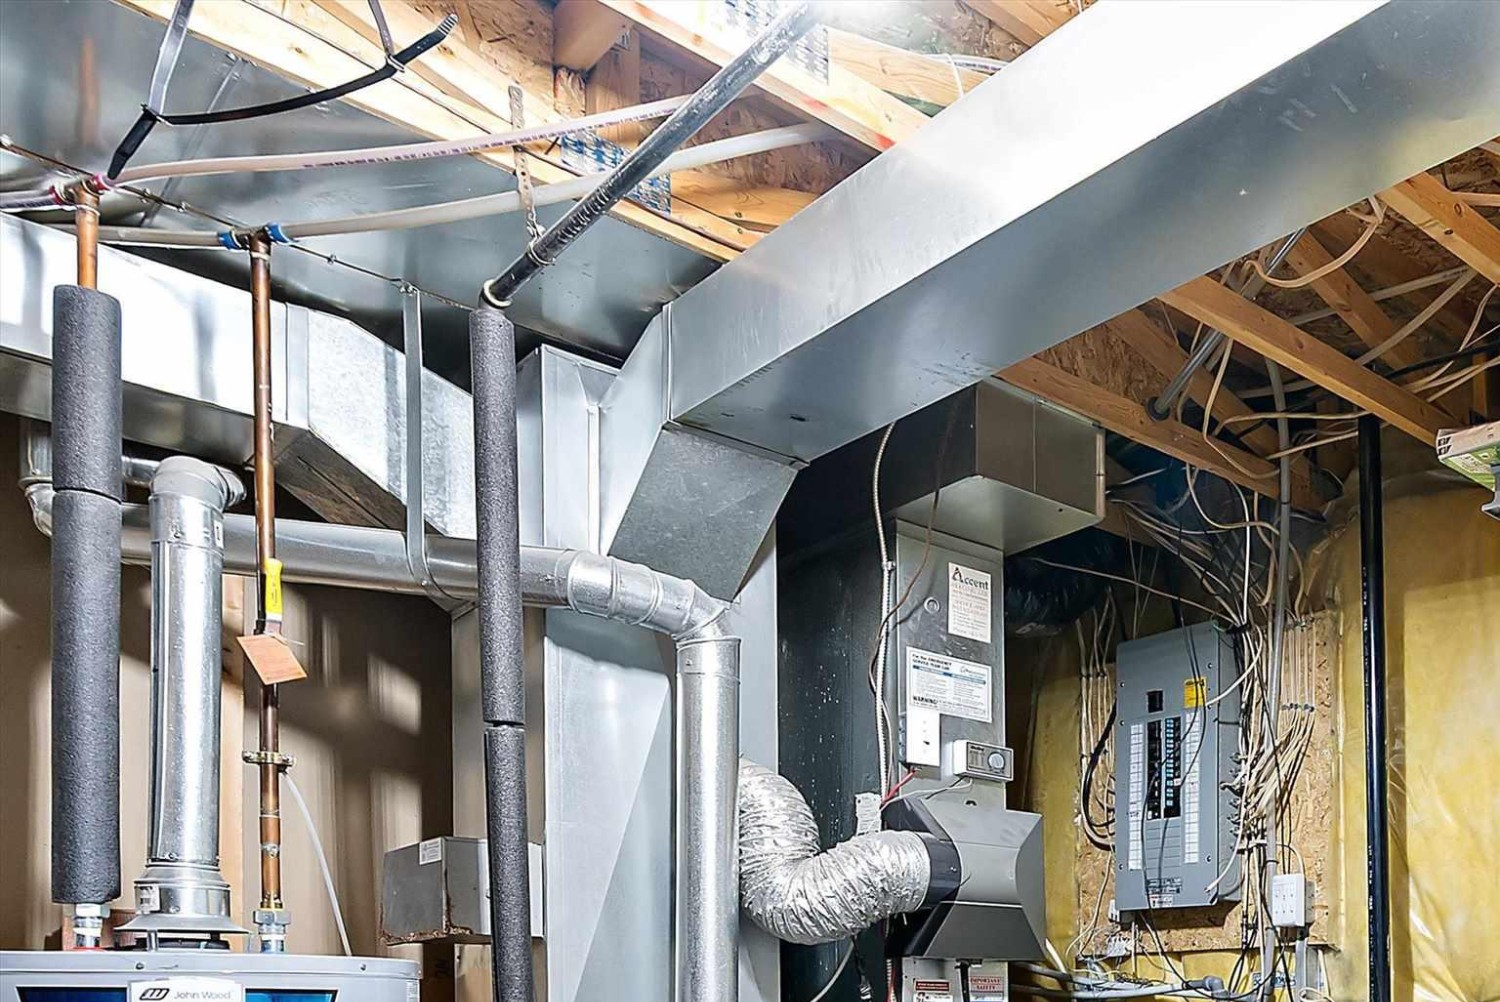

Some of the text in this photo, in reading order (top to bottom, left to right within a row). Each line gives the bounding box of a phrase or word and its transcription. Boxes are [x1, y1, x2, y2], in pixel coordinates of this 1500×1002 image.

[952, 566, 989, 590] Accent
[173, 990, 231, 1000] John Wood
